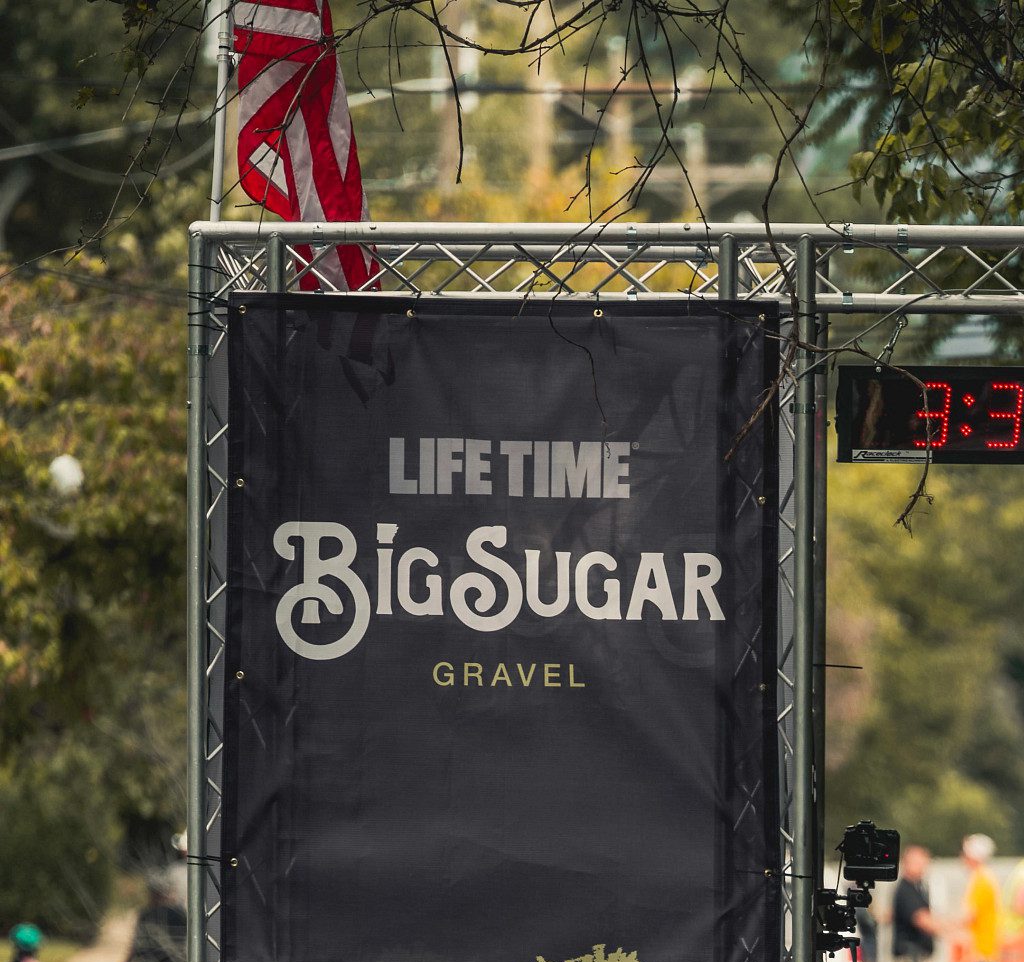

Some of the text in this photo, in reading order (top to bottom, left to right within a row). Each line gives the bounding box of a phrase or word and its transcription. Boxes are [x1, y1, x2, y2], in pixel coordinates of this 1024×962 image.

[389, 437, 630, 498] LIFE TIME
[433, 661, 586, 689] GRAVEL
